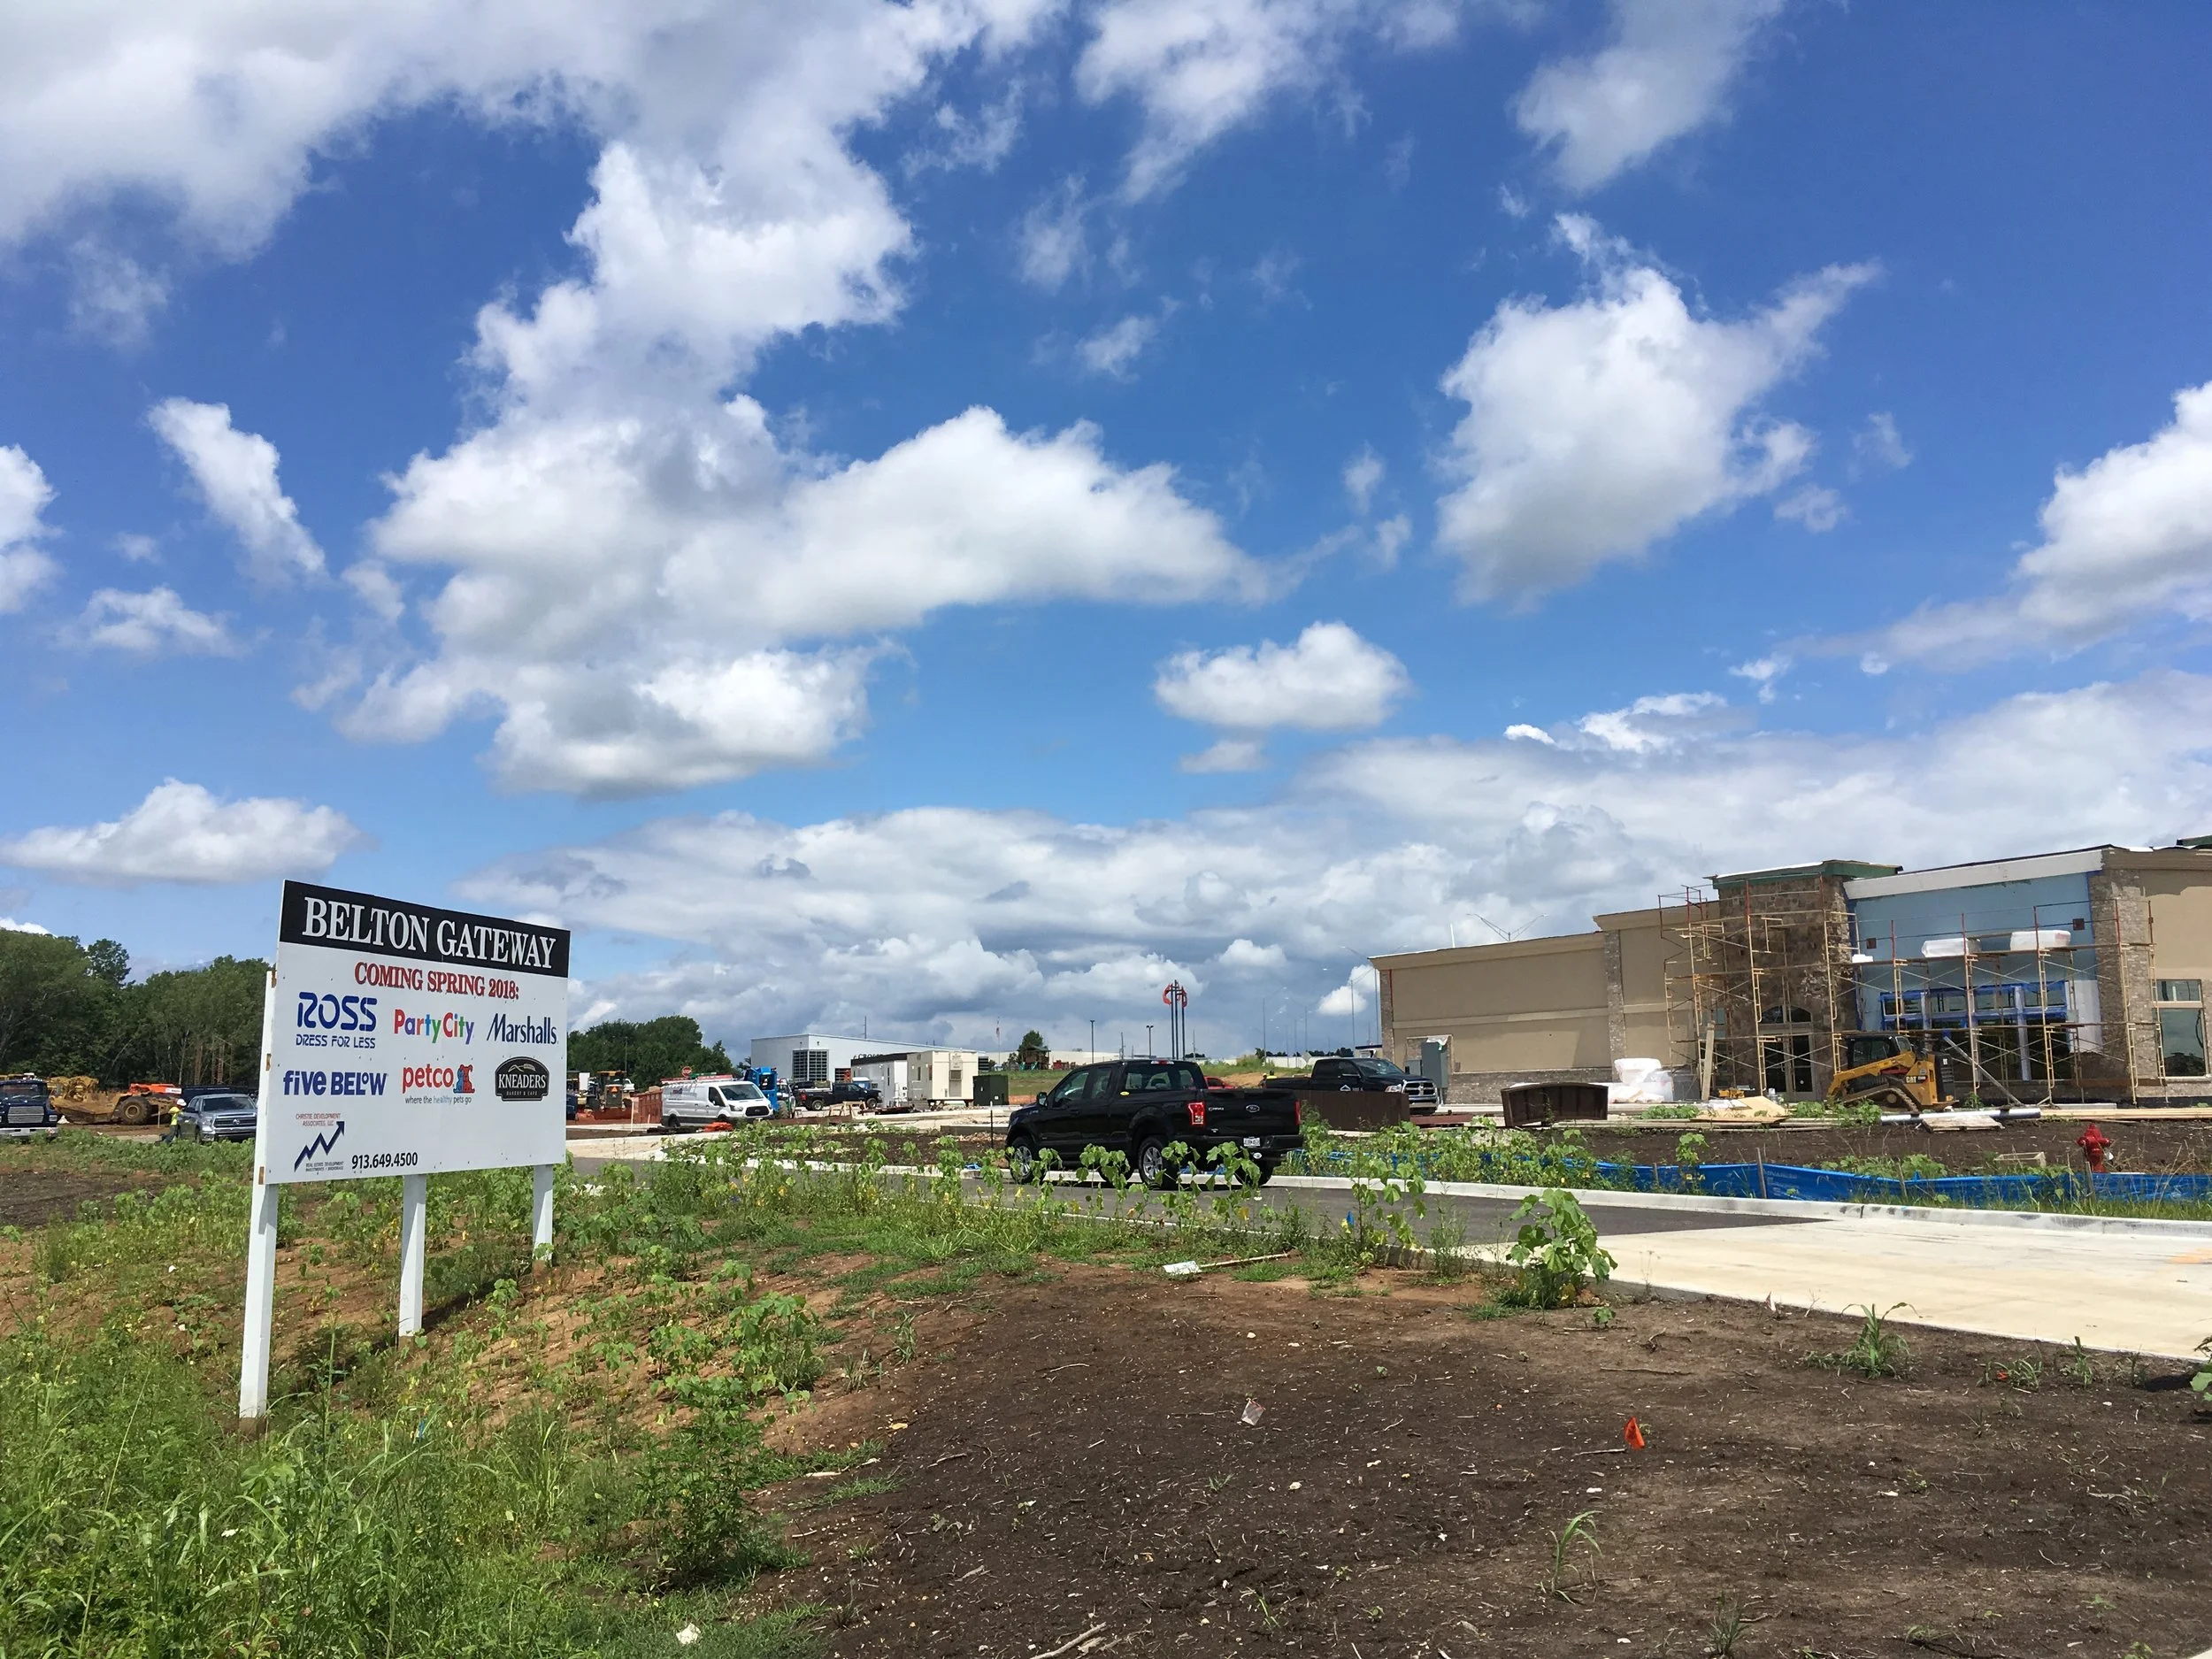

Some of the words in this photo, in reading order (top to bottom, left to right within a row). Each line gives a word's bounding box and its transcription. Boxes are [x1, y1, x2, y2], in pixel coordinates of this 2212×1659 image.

[302, 896, 430, 953] BELTON
[436, 919, 557, 969] GATEWAY
[355, 962, 423, 990] COMING
[427, 970, 486, 997] SPRING
[488, 979, 519, 1000] 2018:
[297, 992, 378, 1032] ROSS
[296, 1033, 328, 1047] DRESS
[331, 1035, 350, 1048] FOR
[353, 1037, 376, 1048] LESS
[487, 1012, 557, 1045] Marshalls
[283, 1070, 327, 1096] five
[402, 1064, 455, 1094] petco
[498, 1073, 547, 1088] KNEADERS
[404, 1095, 423, 1104] where
[423, 1095, 433, 1104] the
[433, 1095, 453, 1105] healthy
[453, 1096, 465, 1105] pets
[351, 1151, 419, 1170] 913.649.4500
